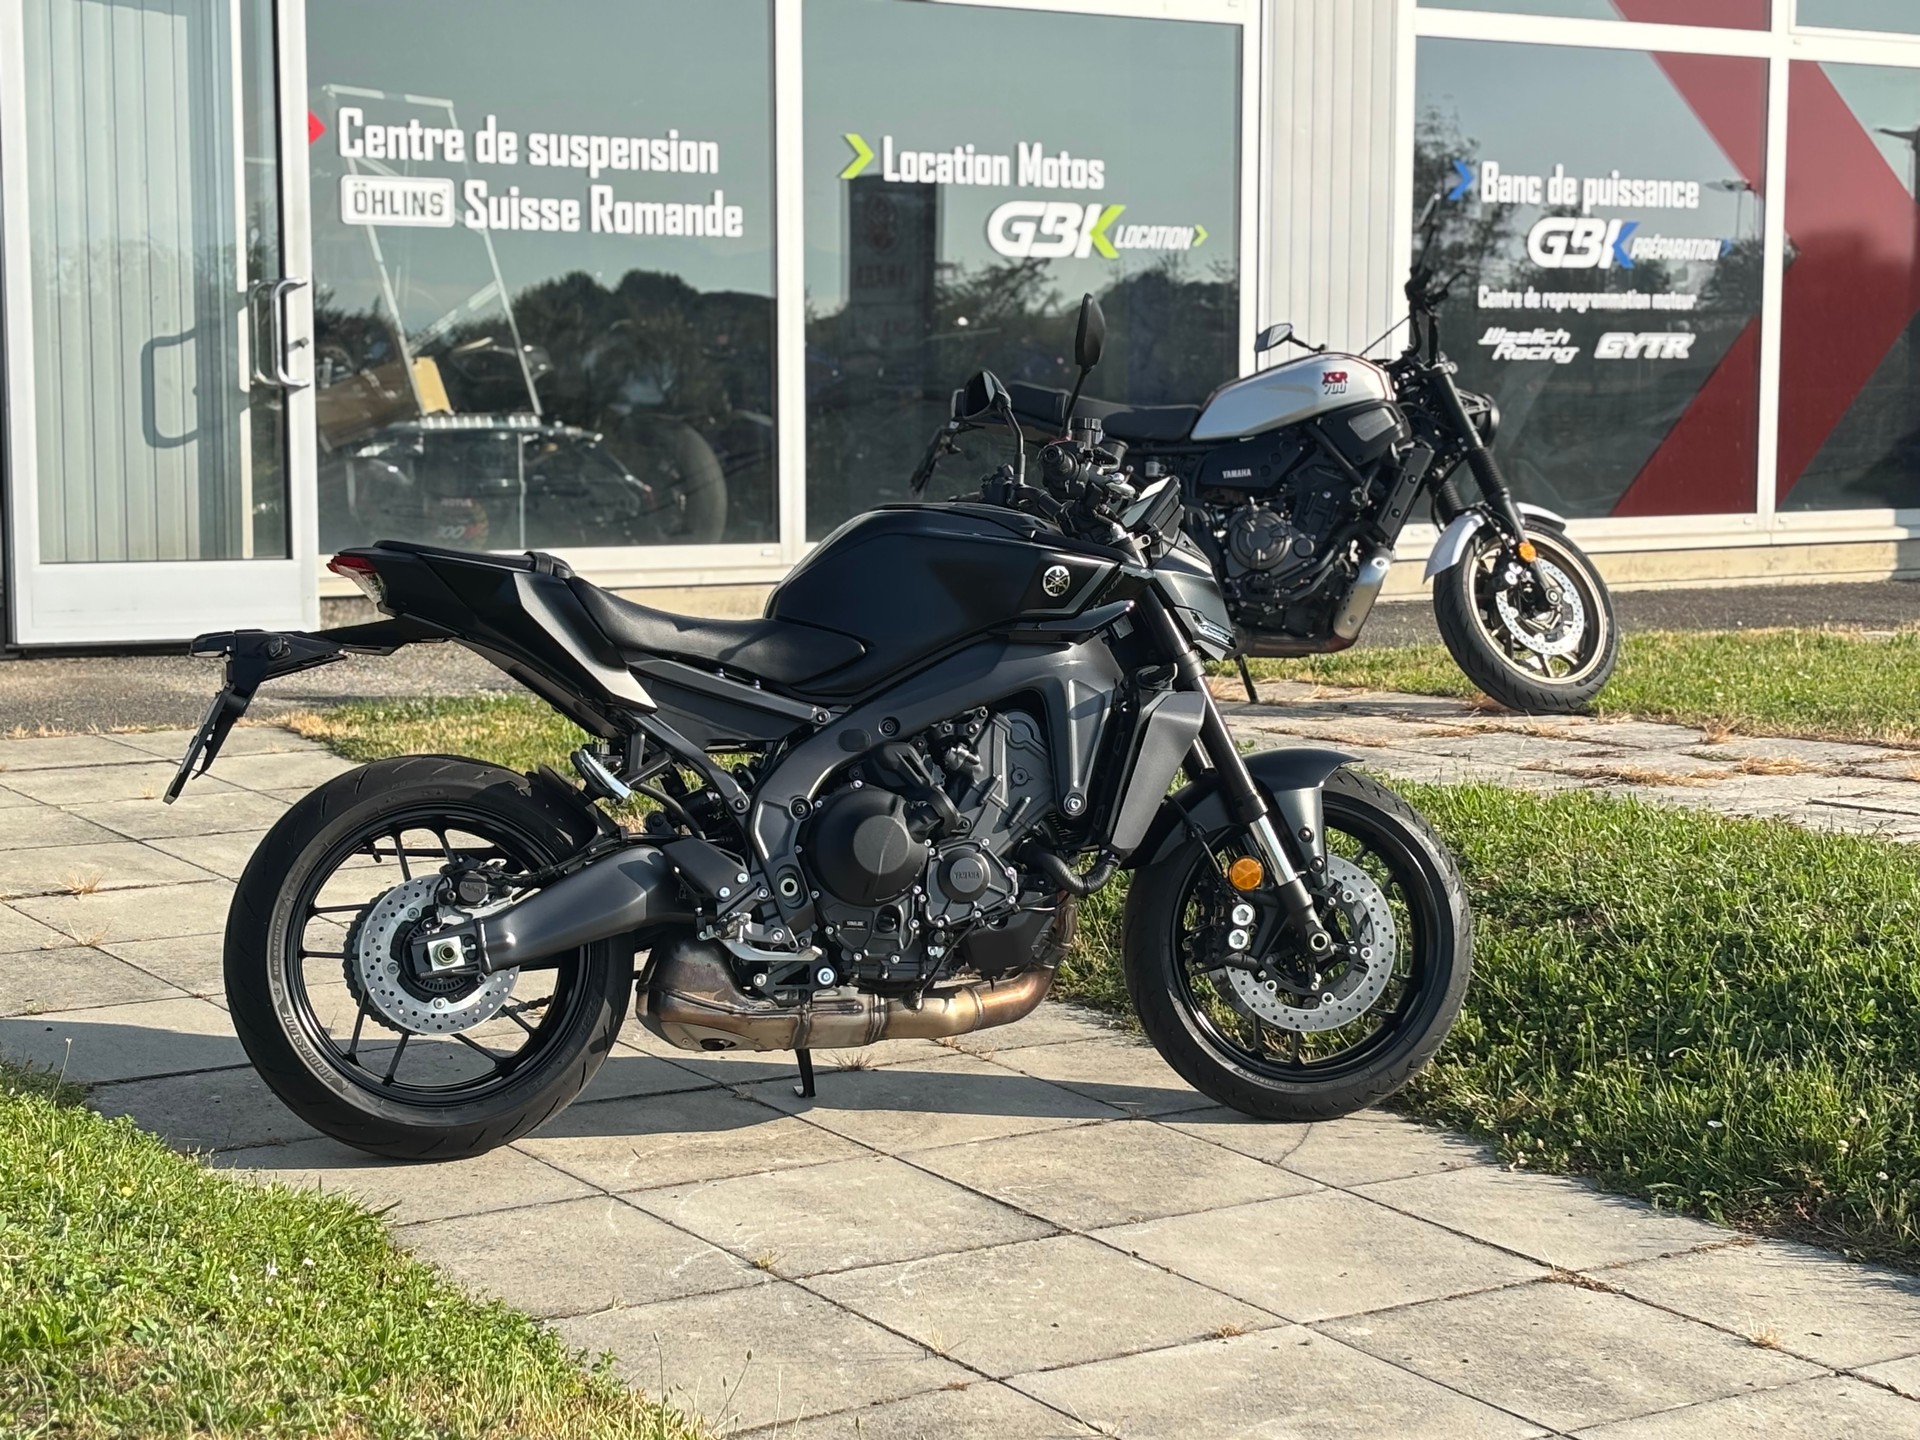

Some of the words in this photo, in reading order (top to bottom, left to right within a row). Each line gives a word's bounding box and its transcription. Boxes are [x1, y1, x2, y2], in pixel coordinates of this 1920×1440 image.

[339, 107, 465, 162] Centre
[475, 115, 518, 164] de
[528, 129, 719, 178] suspension
[882, 135, 1010, 187] Location
[1018, 141, 1105, 190] Motos
[1480, 160, 1542, 205] Banc
[1548, 163, 1577, 206] de
[1582, 169, 1700, 215] puissance
[353, 182, 446, 217] ÖHLINS
[464, 179, 581, 232] Suisse
[590, 184, 744, 238] Romande
[986, 200, 1127, 259] GBK
[1113, 225, 1196, 250] LOCATION
[1527, 216, 1640, 269] GBK
[1478, 285, 1522, 309] Centre
[1524, 286, 1541, 309] de
[1492, 343, 1580, 364] Racing
[1593, 332, 1696, 359] GYTR
[1322, 371, 1348, 385] XSR
[1324, 382, 1347, 395] 700
[1222, 468, 1252, 479] YAMAHA
